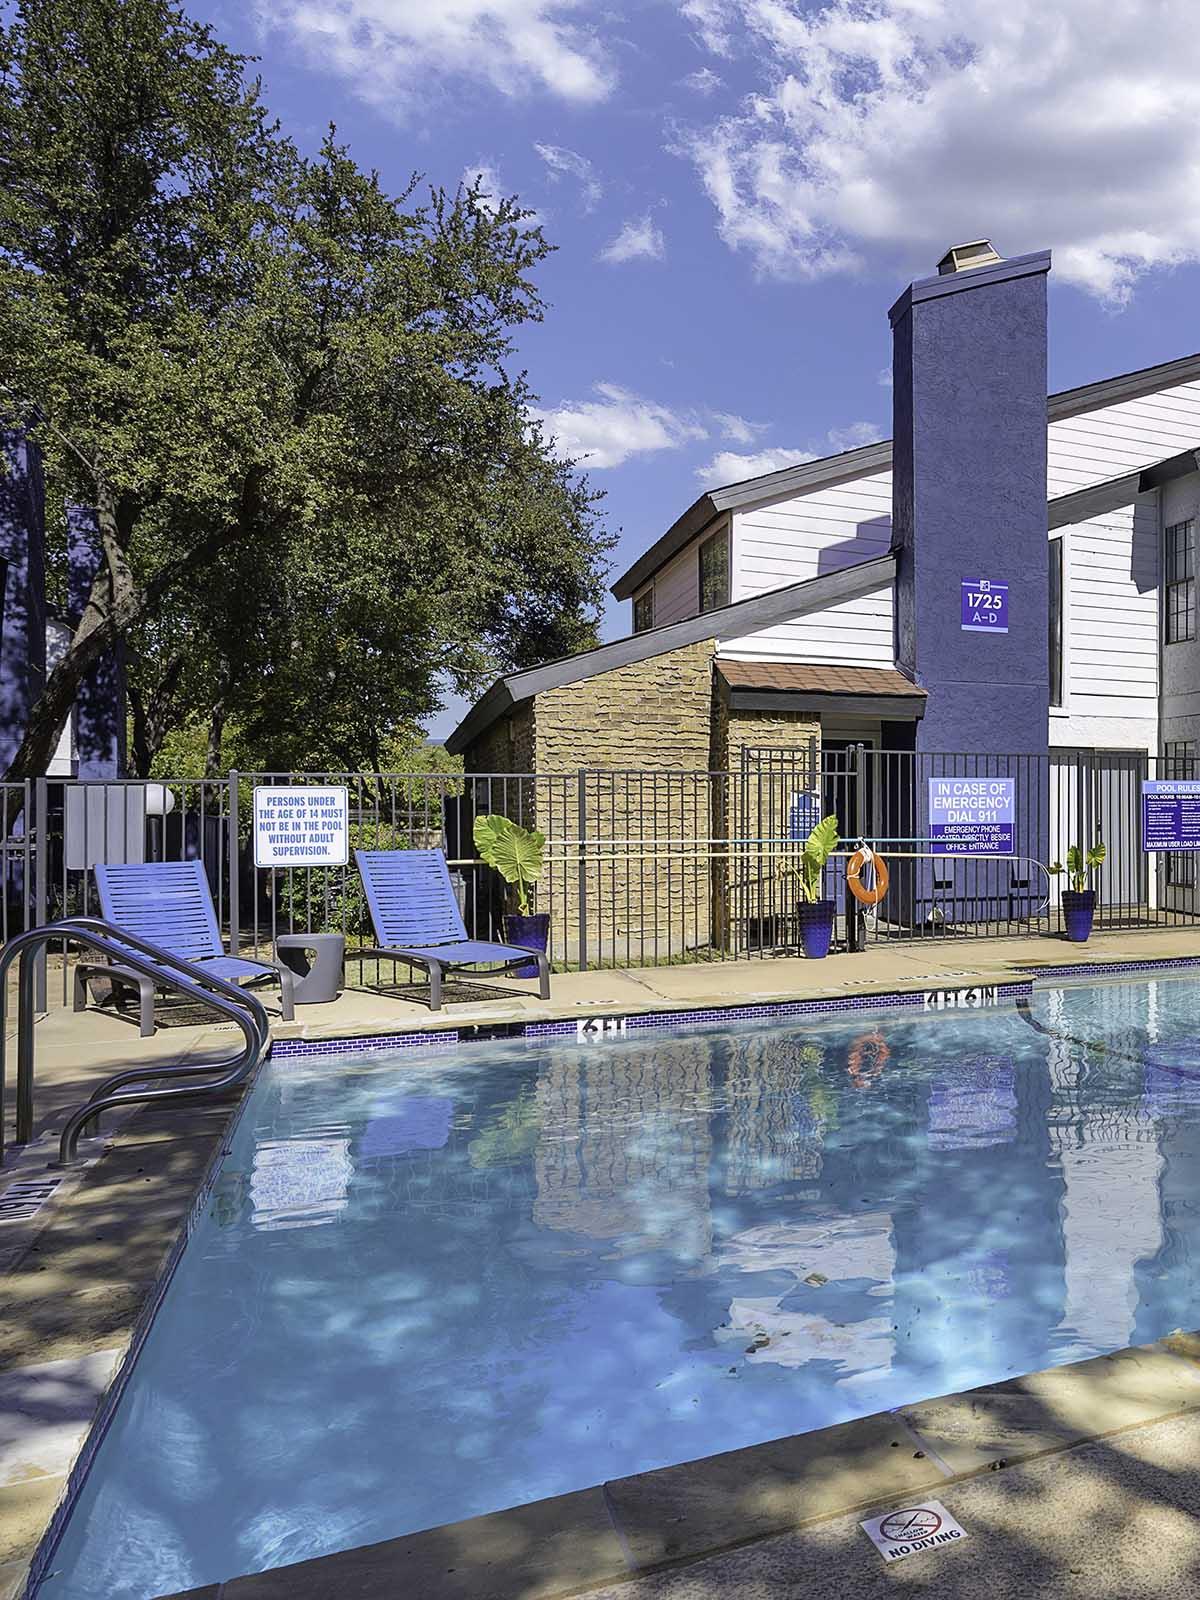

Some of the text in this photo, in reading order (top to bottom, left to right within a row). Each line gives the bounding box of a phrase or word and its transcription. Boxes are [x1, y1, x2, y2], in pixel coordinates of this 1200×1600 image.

[967, 593, 1002, 609] 1725
[972, 611, 998, 623] A-D
[938, 783, 1007, 795] IN CASE OF
[1156, 784, 1200, 792] POOL RULES
[266, 796, 336, 806] PERSONS UNDER
[934, 797, 1011, 809] EMERGENCY
[259, 808, 344, 819] THE AGE OF 14 MUST
[948, 810, 997, 822] DIAL 911
[259, 821, 343, 831] NOT BE IN THE POOL
[944, 825, 1001, 834] EMERGENCY PHONE
[268, 833, 335, 844] WITHOUT ADULT
[991, 833, 1011, 841] BESIDE
[273, 846, 331, 856] SUPERVISION.
[946, 842, 999, 851] OFFICE ENTRANCE
[981, 986, 994, 999] IN
[602, 1017, 622, 1031] FT
[888, 1529, 961, 1558] NO DIVING
